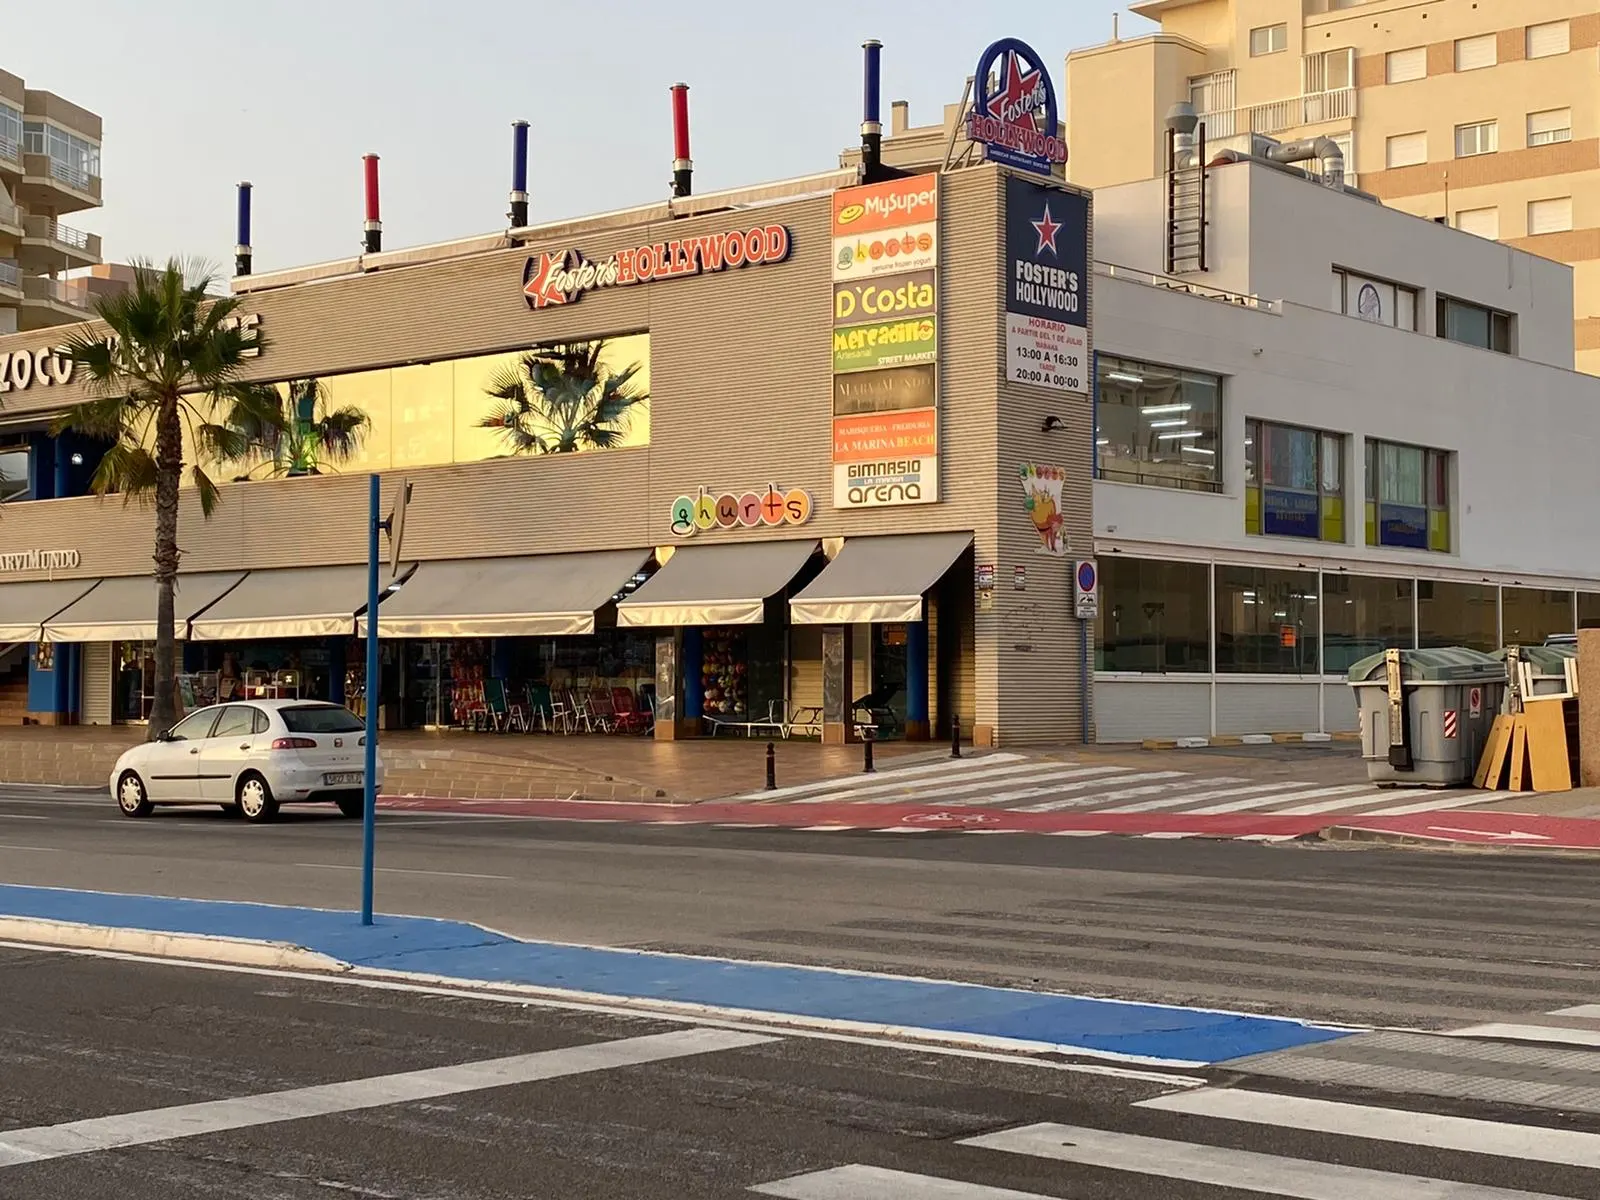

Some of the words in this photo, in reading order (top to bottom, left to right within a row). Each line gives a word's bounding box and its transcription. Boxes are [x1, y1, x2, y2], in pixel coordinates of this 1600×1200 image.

[1000, 83, 1047, 128] Foster's
[972, 112, 1068, 163] HOLLYWOOD
[864, 188, 936, 218] MySuper
[541, 255, 619, 297] Foster's
[616, 224, 788, 285] HOLLYWOOD
[1016, 259, 1078, 292] FOSTER'S
[1016, 280, 1078, 313] HOLLYWOOD
[1028, 317, 1066, 333] HORARIO
[878, 355, 903, 365] STREET
[904, 351, 936, 361] MARKET
[1016, 346, 1042, 361] 13:00
[1044, 351, 1051, 362] A
[1054, 353, 1078, 367] 16:30
[1016, 368, 1042, 383] 20:00
[1044, 373, 1051, 383] A
[1053, 374, 1079, 388] 00:00
[834, 441, 849, 454] LA
[851, 437, 896, 451] MARINA
[897, 433, 935, 448] BEACH
[847, 459, 921, 478] GIMNASIO
[670, 483, 802, 536] ghurts
